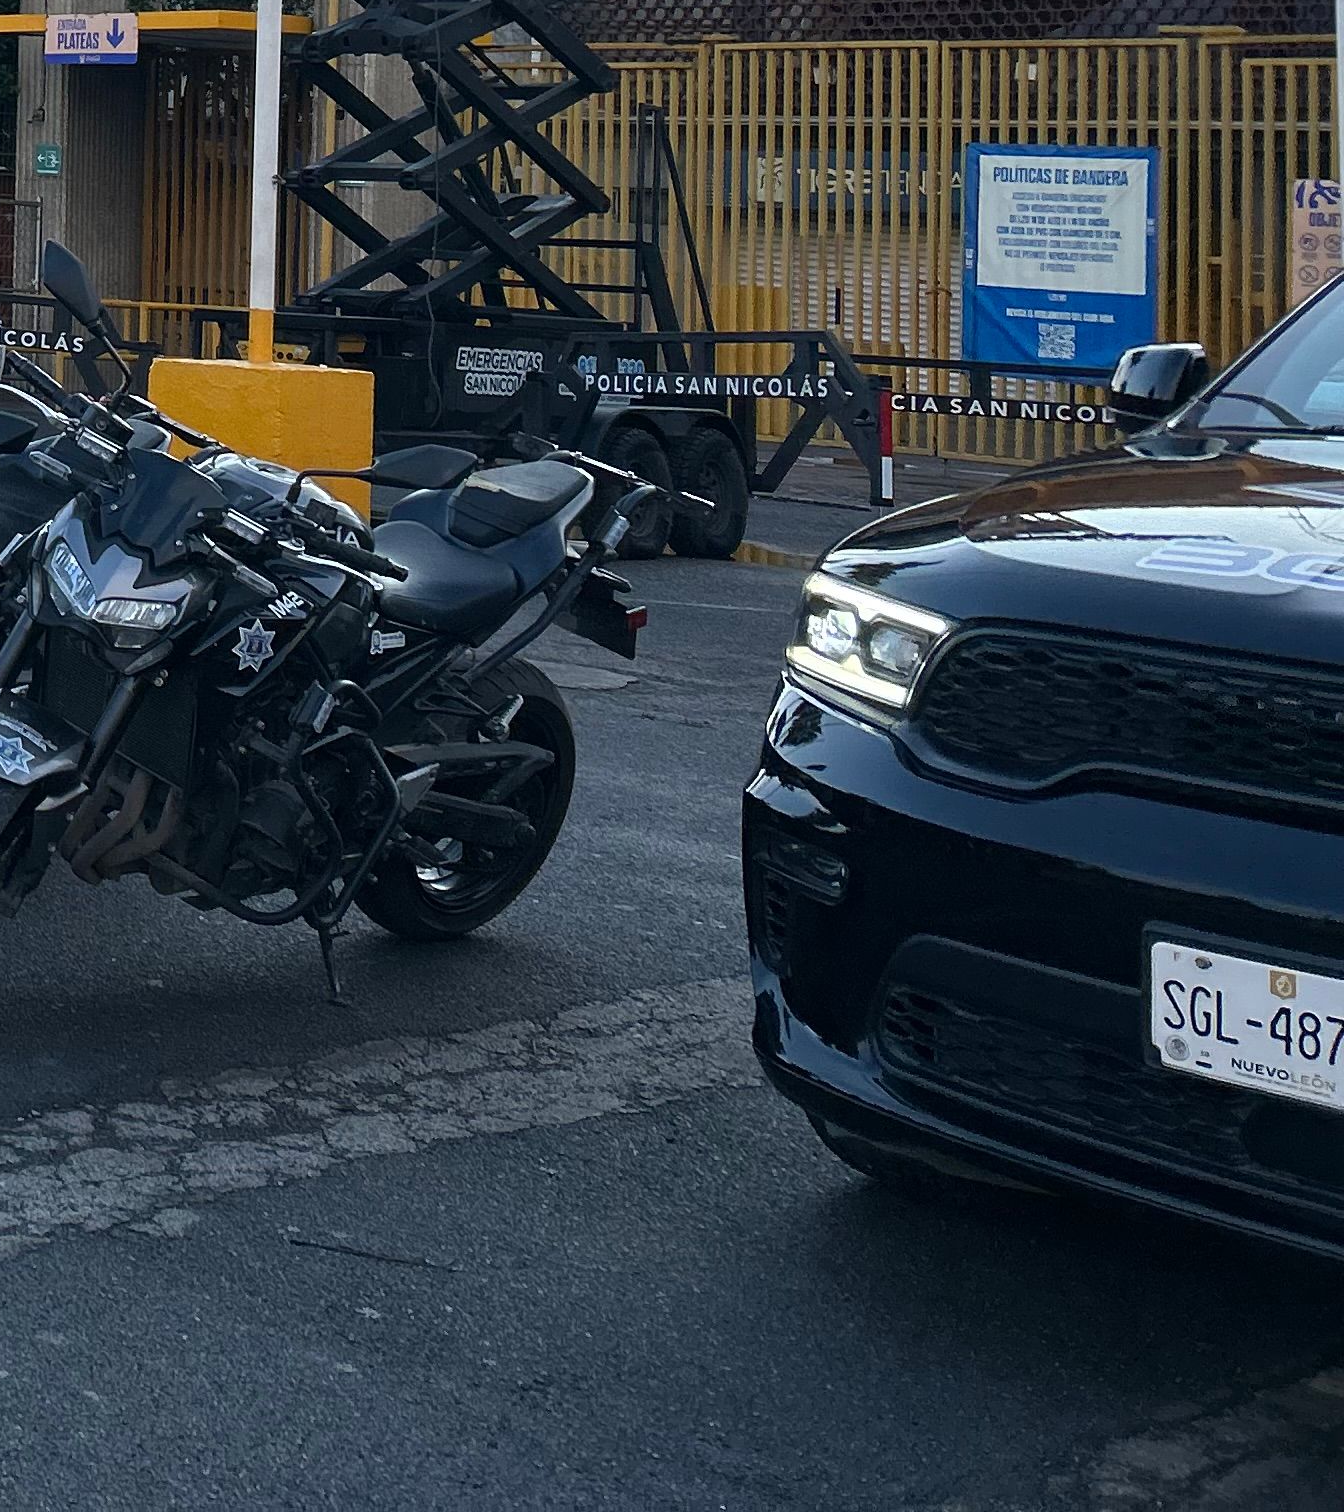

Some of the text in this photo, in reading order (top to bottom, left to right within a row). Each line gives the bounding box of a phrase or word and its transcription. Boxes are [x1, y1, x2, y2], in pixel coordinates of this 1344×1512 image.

[57, 32, 99, 49] PLATEAS
[993, 165, 1052, 185] POLÍTICAS
[1054, 167, 1069, 185] DE
[456, 346, 544, 373] EMERGENCIAS
[464, 372, 487, 395] SAN
[585, 373, 829, 398] POLICIA SAN NICOLÁS
[949, 397, 1008, 417] SAN
[1020, 401, 1117, 424] NICOL
[268, 590, 305, 619] M42
